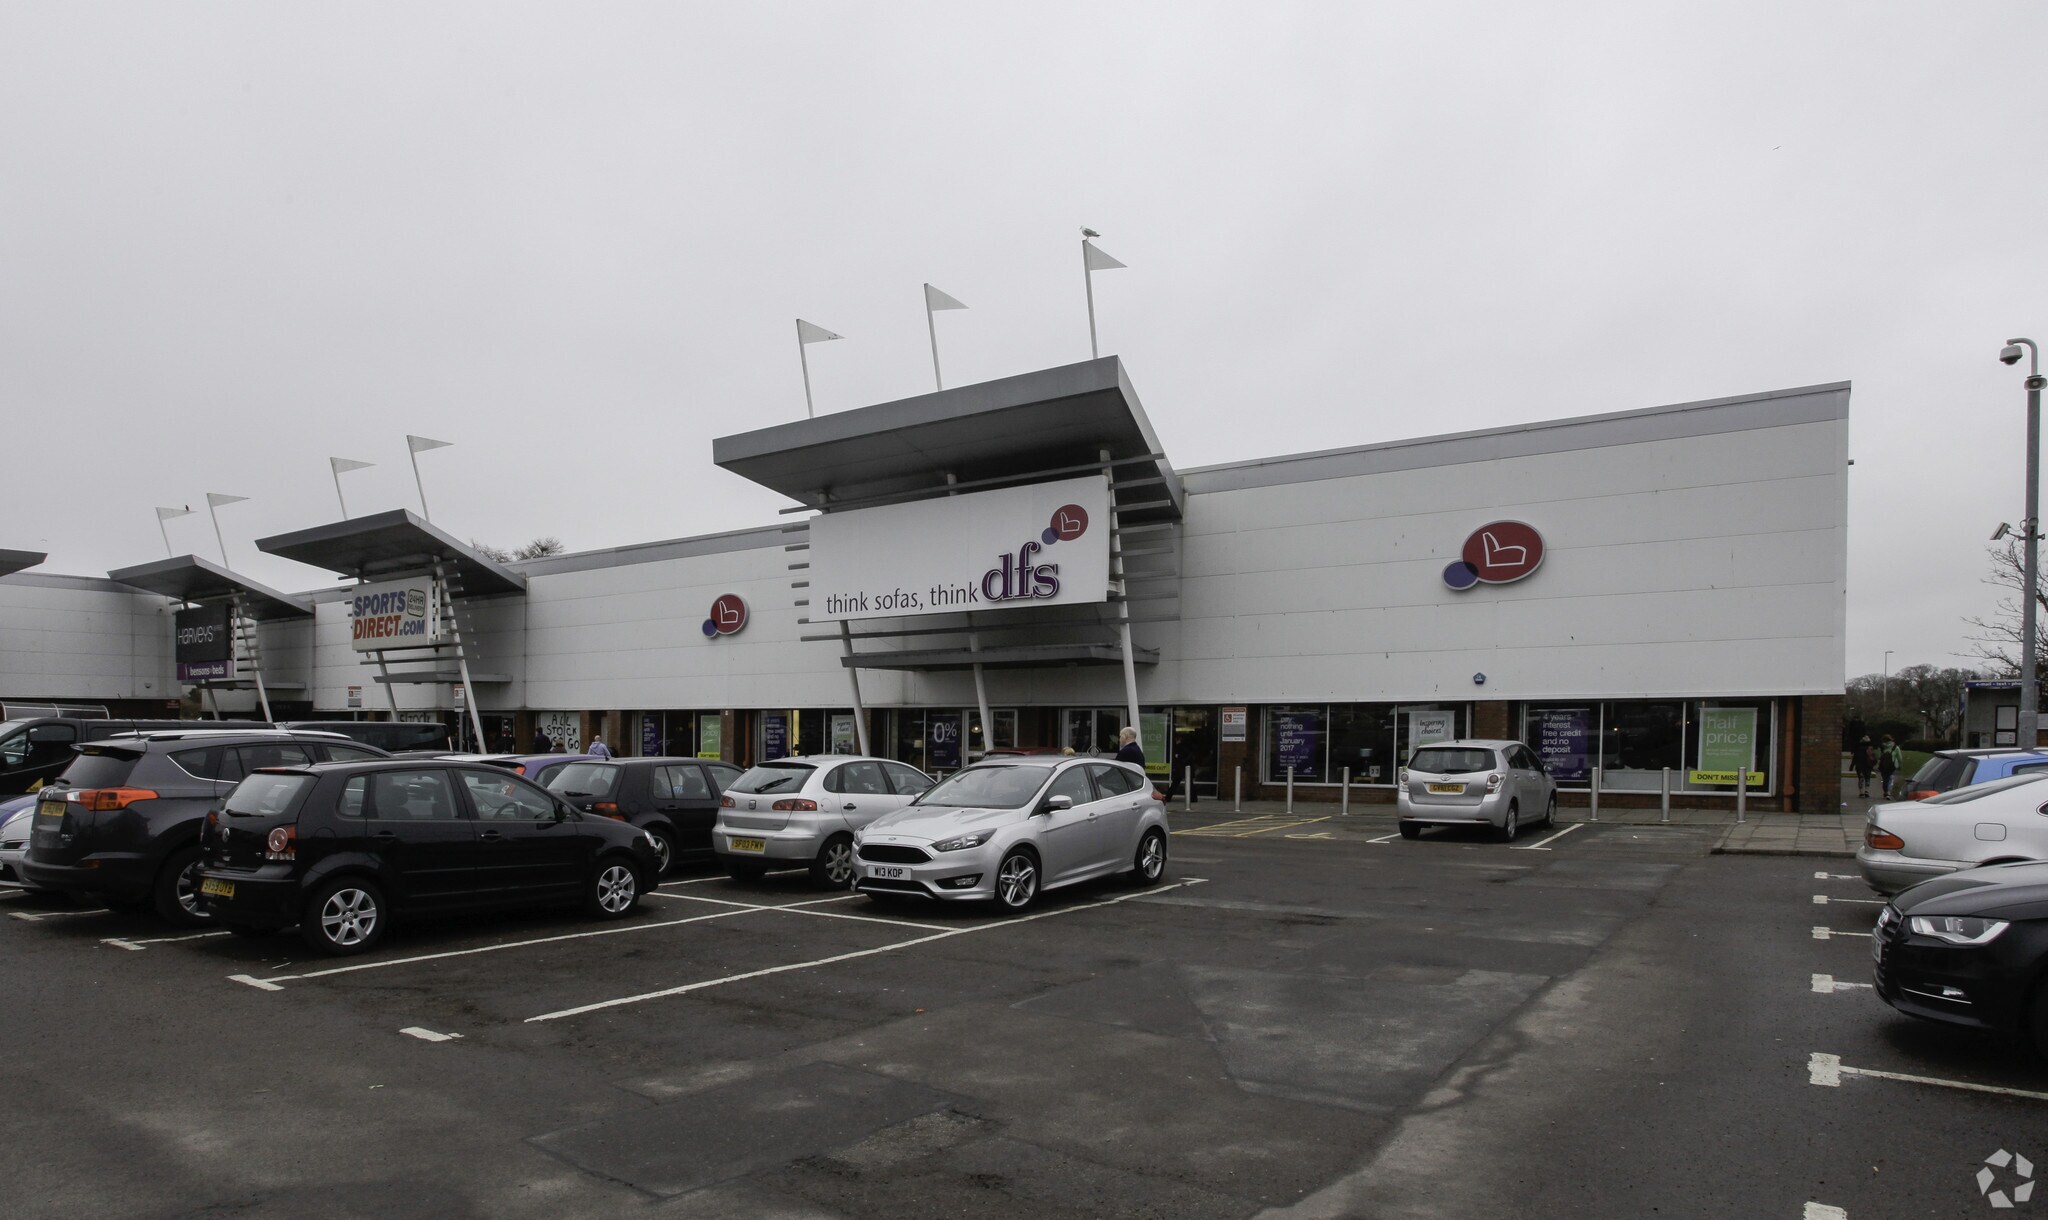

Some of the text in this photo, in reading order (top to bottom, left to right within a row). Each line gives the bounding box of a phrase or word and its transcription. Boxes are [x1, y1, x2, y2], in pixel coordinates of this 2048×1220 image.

[826, 541, 1061, 614] think sofas, think dfs
[354, 590, 406, 617] SPORTS
[353, 614, 425, 639] DIRECT.COM
[189, 664, 224, 676] bensons beds
[551, 713, 572, 727] ALL
[1550, 714, 1572, 723] years
[1707, 715, 1738, 729] half
[546, 725, 577, 736] STOCK
[1280, 723, 1304, 731] nothing
[1542, 721, 1571, 729] interest
[934, 722, 957, 743] 0%
[1421, 727, 1442, 735] choices
[1280, 738, 1305, 746] January
[1706, 730, 1748, 747] price
[567, 739, 580, 750] GO
[1542, 746, 1571, 755] deposit
[874, 867, 903, 878] W13 KOP
